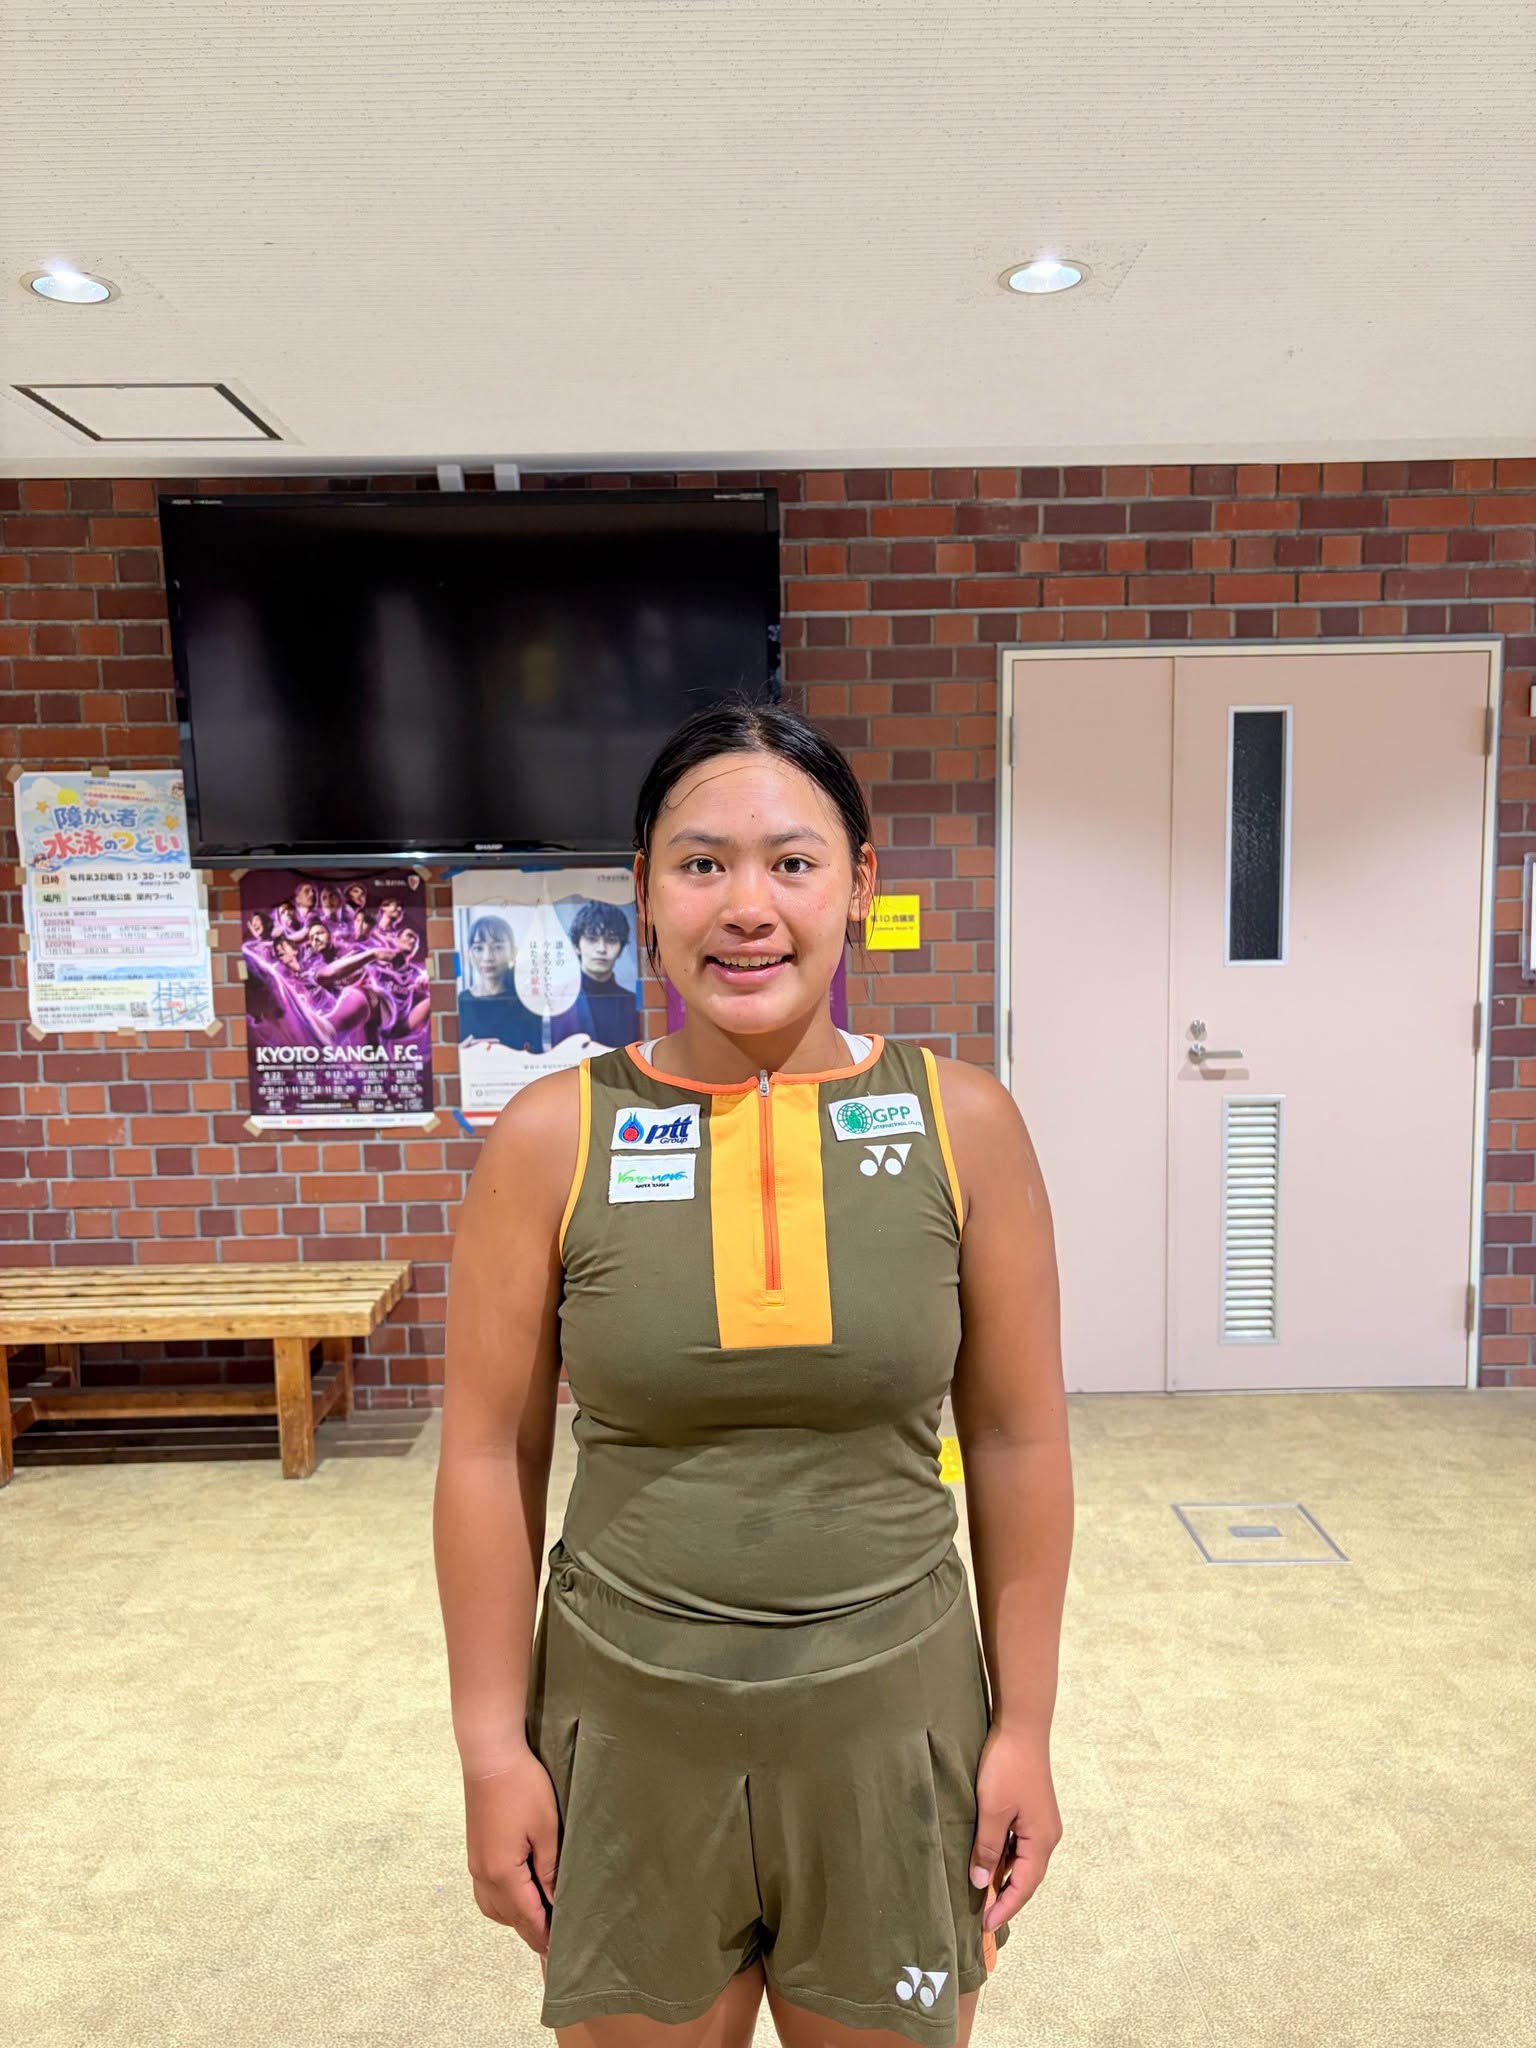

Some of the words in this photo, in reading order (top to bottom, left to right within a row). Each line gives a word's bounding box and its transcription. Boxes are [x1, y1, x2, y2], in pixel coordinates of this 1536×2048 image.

[54, 805, 138, 829] 障がい者
[43, 829, 180, 860] 水泳のつどい
[256, 1046, 319, 1063] KYOTO
[322, 1045, 389, 1062] SANGA
[394, 1045, 423, 1061] F.C.
[873, 1105, 911, 1122] GPP
[644, 1115, 693, 1144] ptt
